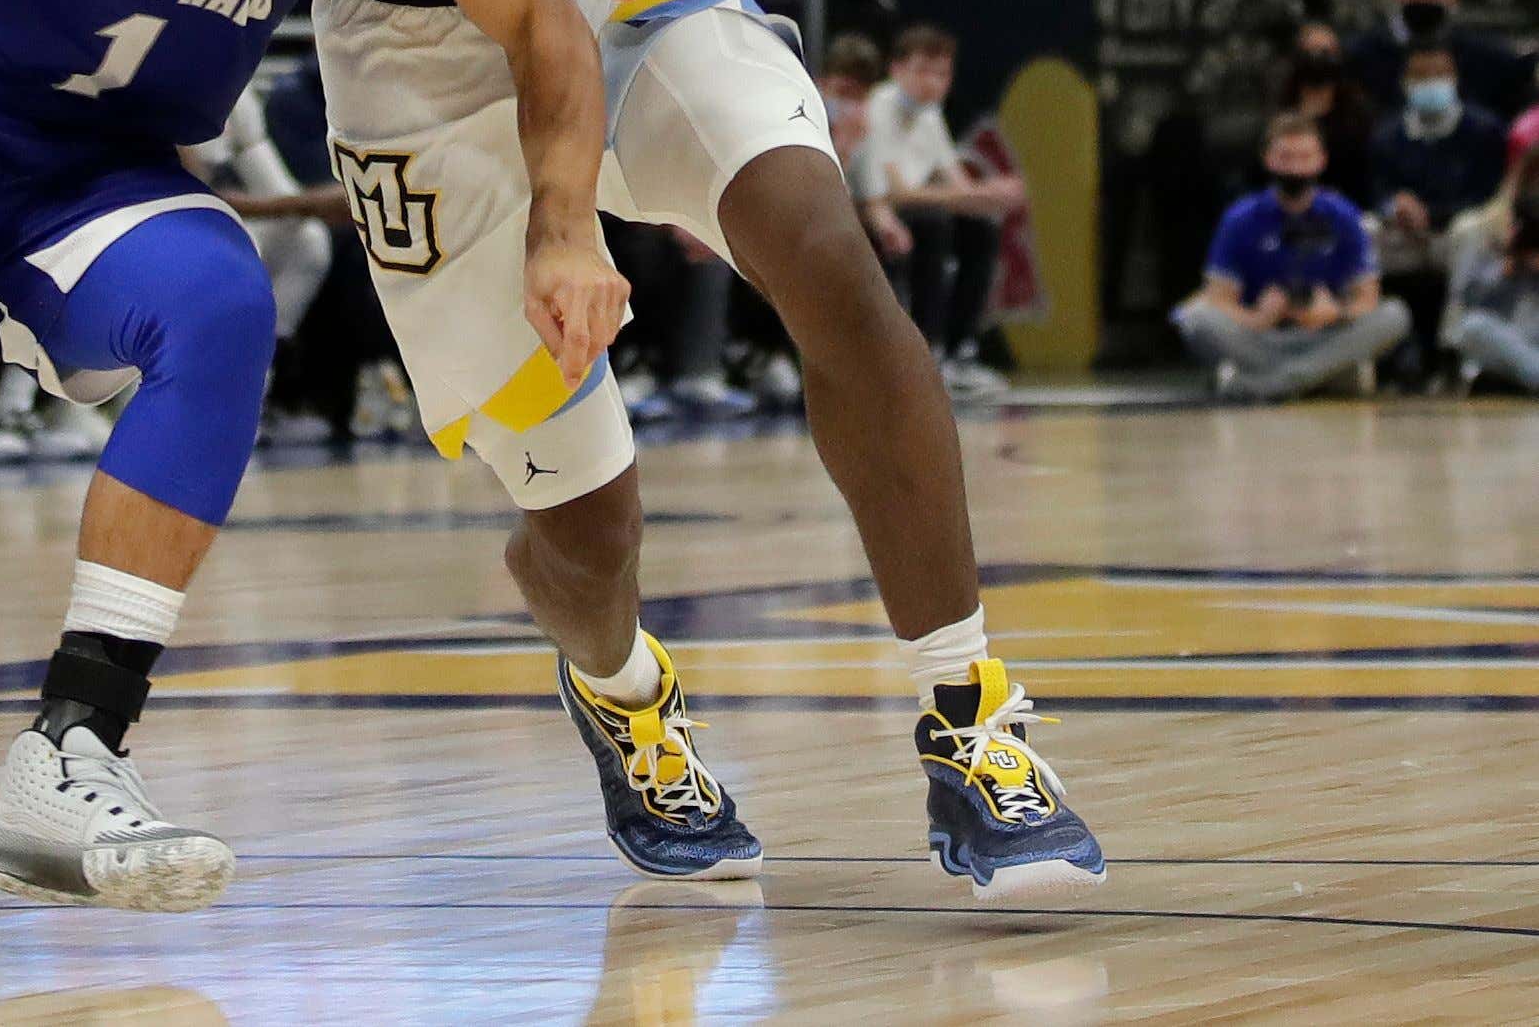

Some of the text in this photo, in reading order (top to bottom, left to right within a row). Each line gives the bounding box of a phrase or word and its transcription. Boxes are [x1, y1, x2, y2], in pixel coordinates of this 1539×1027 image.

[52, 12, 169, 99] 1
[332, 140, 443, 275] MU
[984, 749, 1020, 770] MU
